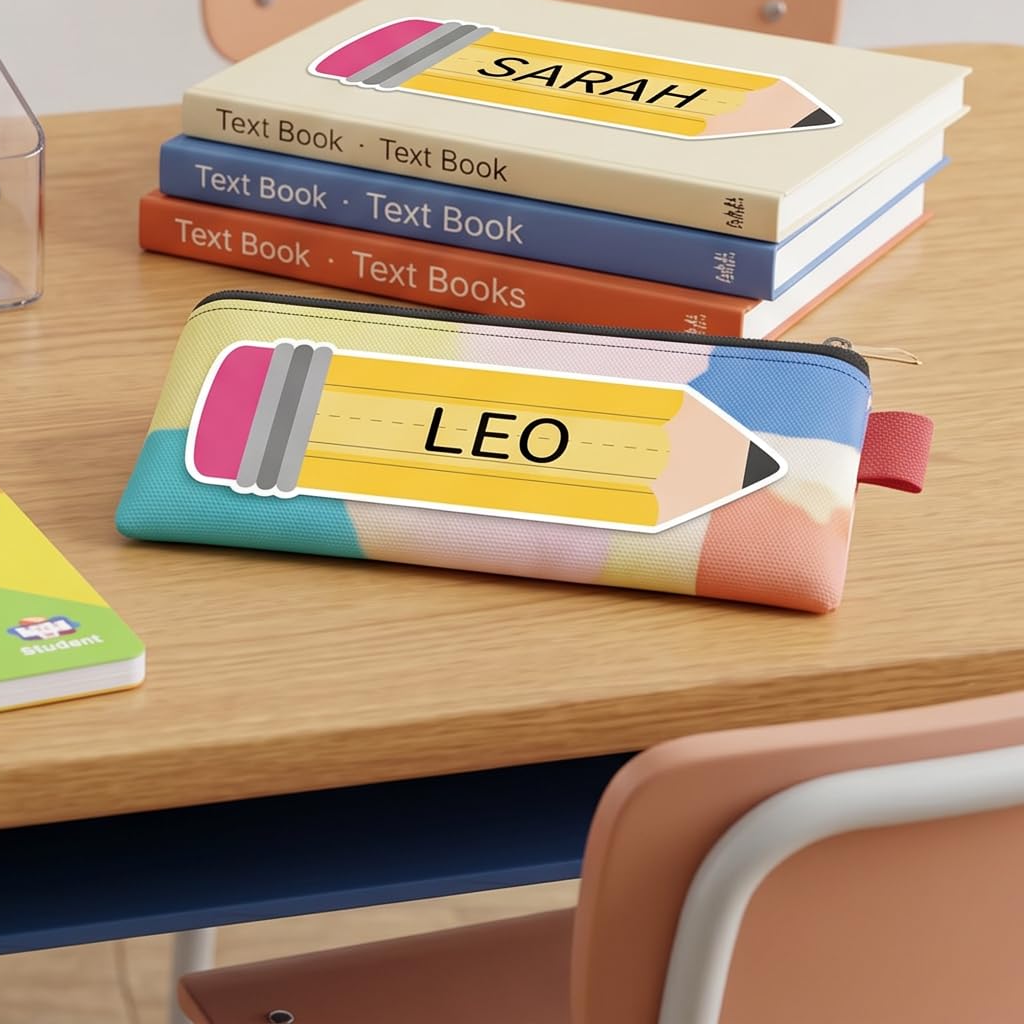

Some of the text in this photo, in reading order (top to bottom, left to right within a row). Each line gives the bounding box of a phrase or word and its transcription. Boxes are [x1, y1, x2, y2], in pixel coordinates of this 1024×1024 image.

[477, 57, 707, 109] SARAH
[216, 108, 507, 182] Text Book Text Book
[195, 164, 523, 244] Text Book Text Book
[175, 219, 526, 309] Text Book Text Books
[424, 407, 570, 464] LEO
[20, 634, 104, 656] Student
